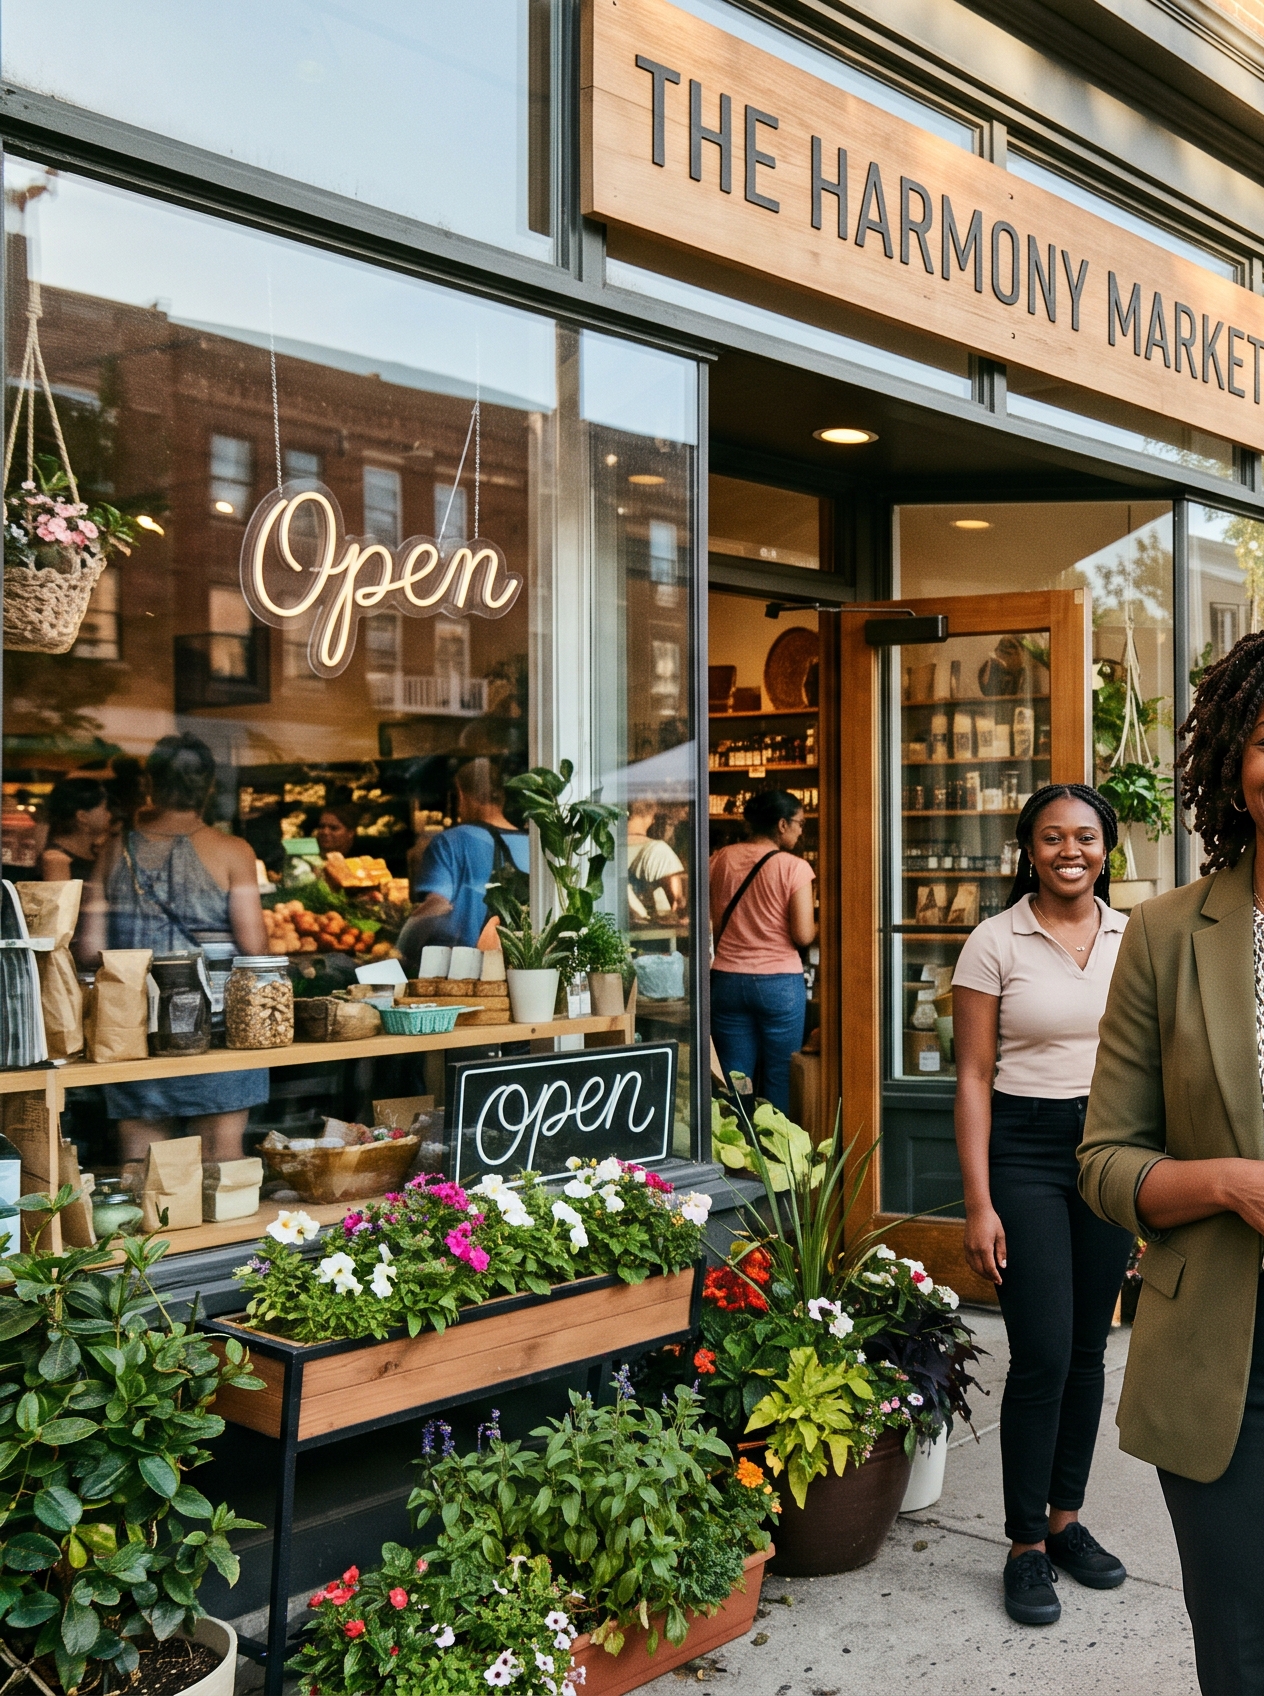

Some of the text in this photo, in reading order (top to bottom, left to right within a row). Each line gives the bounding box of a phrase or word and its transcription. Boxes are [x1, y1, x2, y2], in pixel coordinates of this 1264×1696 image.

[634, 53, 781, 214] THE
[810, 135, 1090, 332] HARMONY
[255, 491, 518, 667] Open
